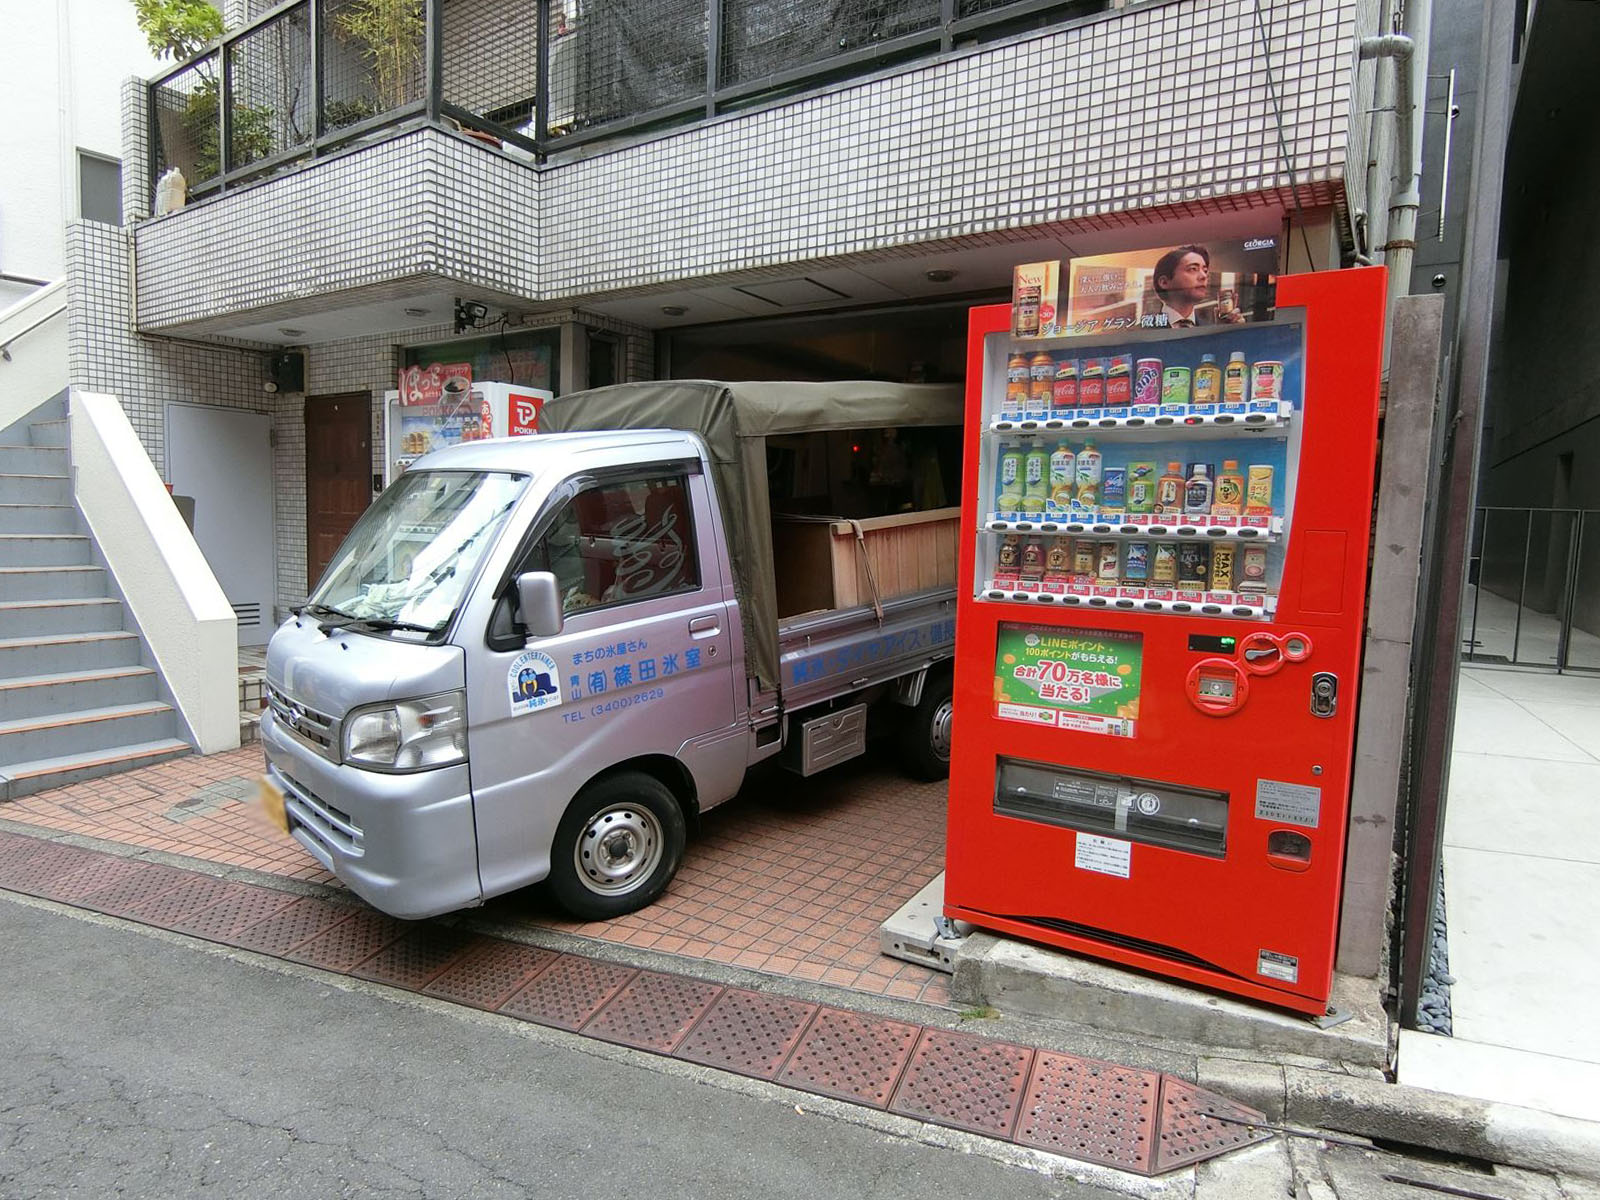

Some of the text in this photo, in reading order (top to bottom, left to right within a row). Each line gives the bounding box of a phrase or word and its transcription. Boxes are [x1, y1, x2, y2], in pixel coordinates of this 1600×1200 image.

[1018, 274, 1042, 285] New
[1042, 313, 1168, 335] ジョージア グラン 微糖
[1135, 369, 1158, 397] anta
[1220, 552, 1231, 578] MAX
[572, 639, 648, 666] まちの氷屋さん
[1040, 637, 1105, 651] LINEポイント
[570, 674, 582, 701] 青山
[1015, 661, 1121, 688] 合計70万名様に
[562, 688, 665, 724] TEL (3400)2629
[1040, 684, 1089, 702] 当たる!
